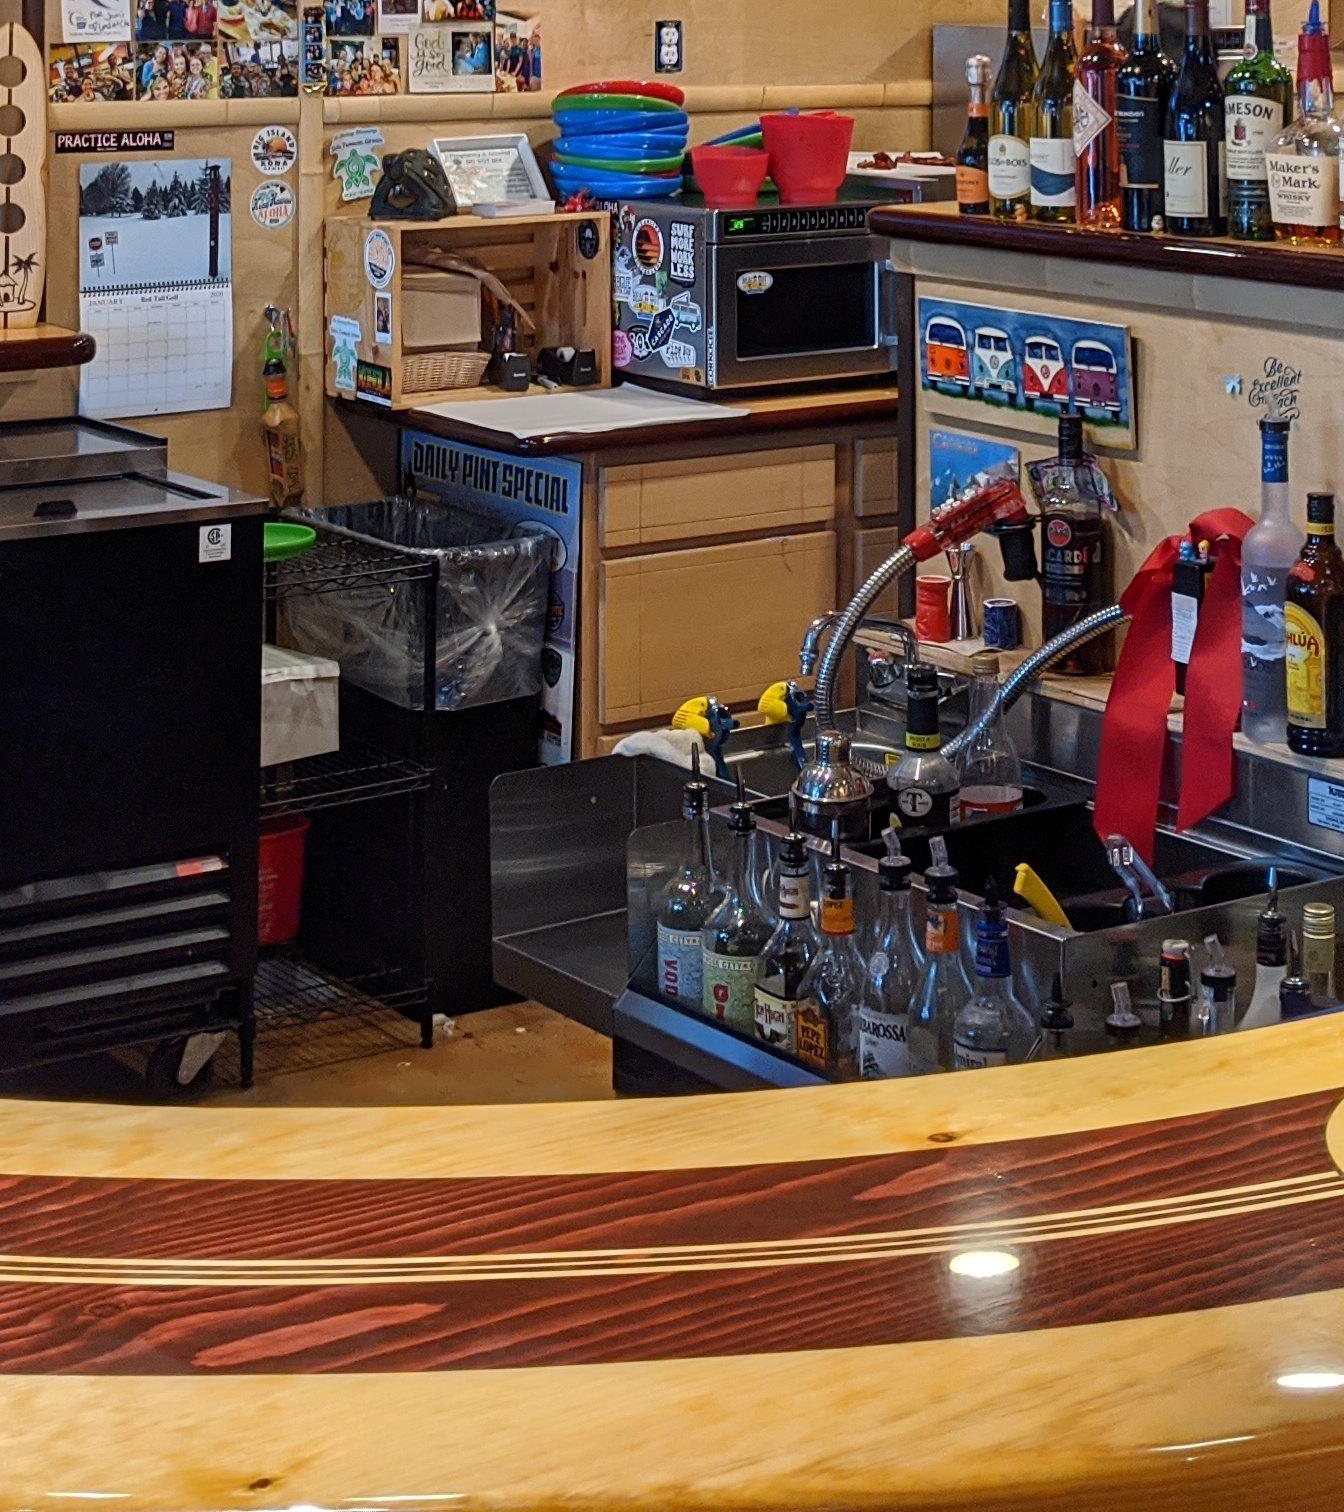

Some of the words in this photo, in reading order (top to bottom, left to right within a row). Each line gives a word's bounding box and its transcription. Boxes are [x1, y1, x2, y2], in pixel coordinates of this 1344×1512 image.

[57, 134, 118, 148] PRACTICE
[121, 132, 162, 147] ALOHA
[1269, 159, 1320, 175] Maker's
[1280, 175, 1322, 190] Mark
[670, 264, 695, 279] LESS
[413, 442, 461, 483] DAILY
[463, 451, 500, 494] PINT
[502, 463, 569, 516] SPECIAL
[1287, 631, 1320, 657] HLÚA
[800, 1023, 824, 1043] PEPE
[799, 1039, 826, 1060] LOPEZ
